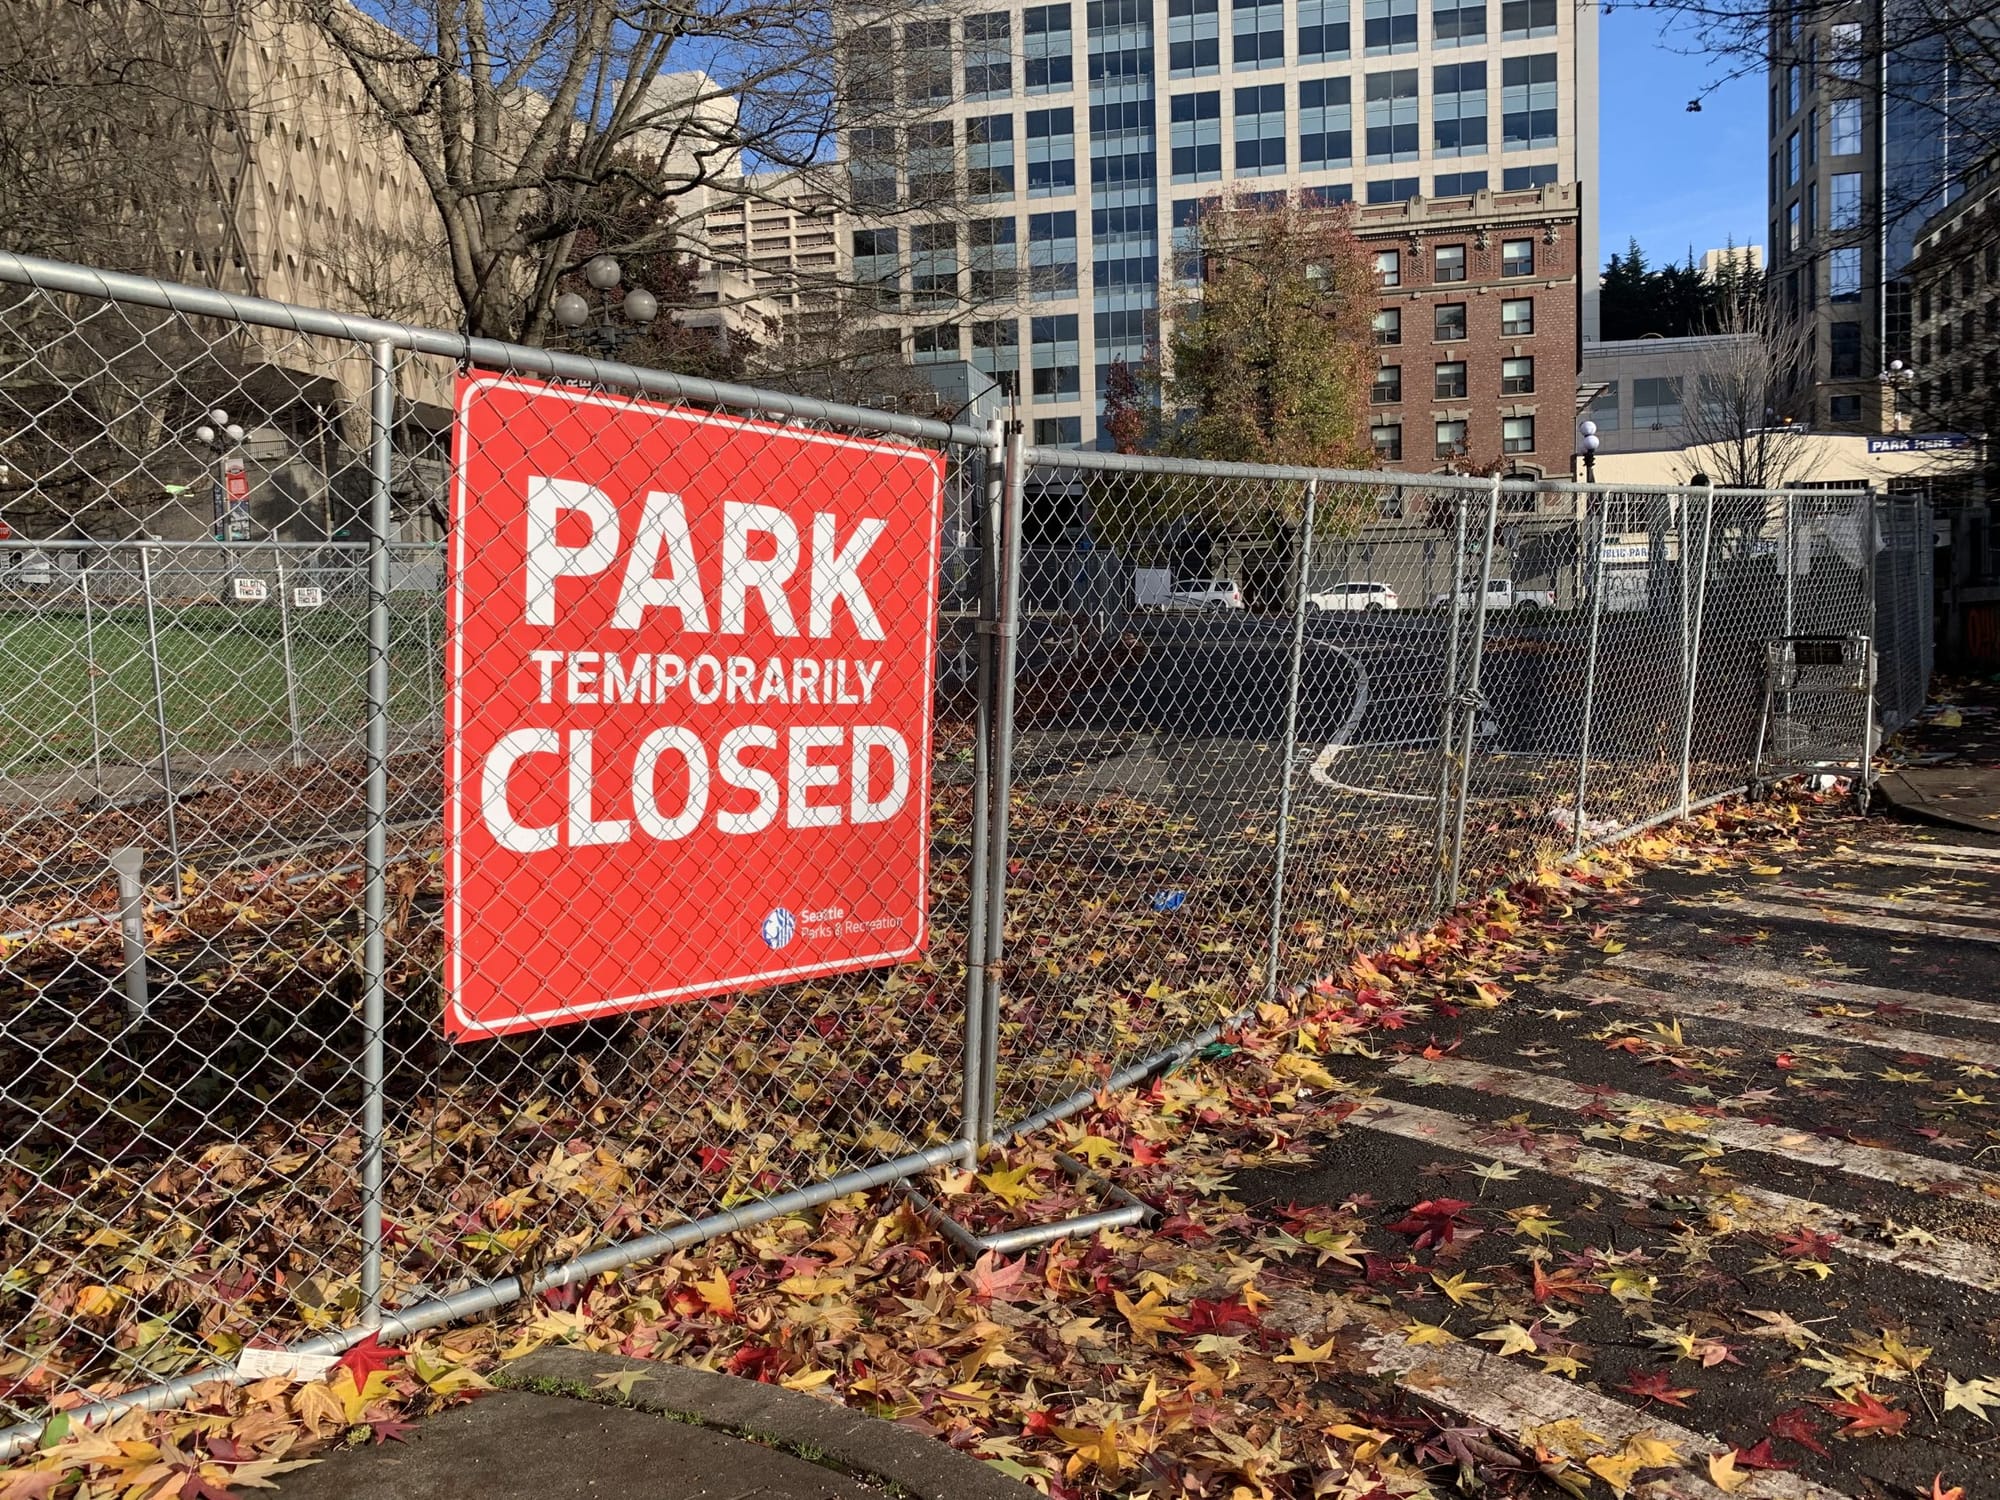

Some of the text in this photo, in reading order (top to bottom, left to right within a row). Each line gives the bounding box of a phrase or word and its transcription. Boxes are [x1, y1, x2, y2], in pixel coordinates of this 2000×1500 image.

[1871, 439, 1909, 451] PARK
[525, 475, 889, 641] PARK
[529, 649, 883, 706] TEMPORARILY
[480, 725, 910, 853] CLOSED
[801, 907, 844, 923] Seattle
[801, 916, 903, 940] Parks & Recreation
